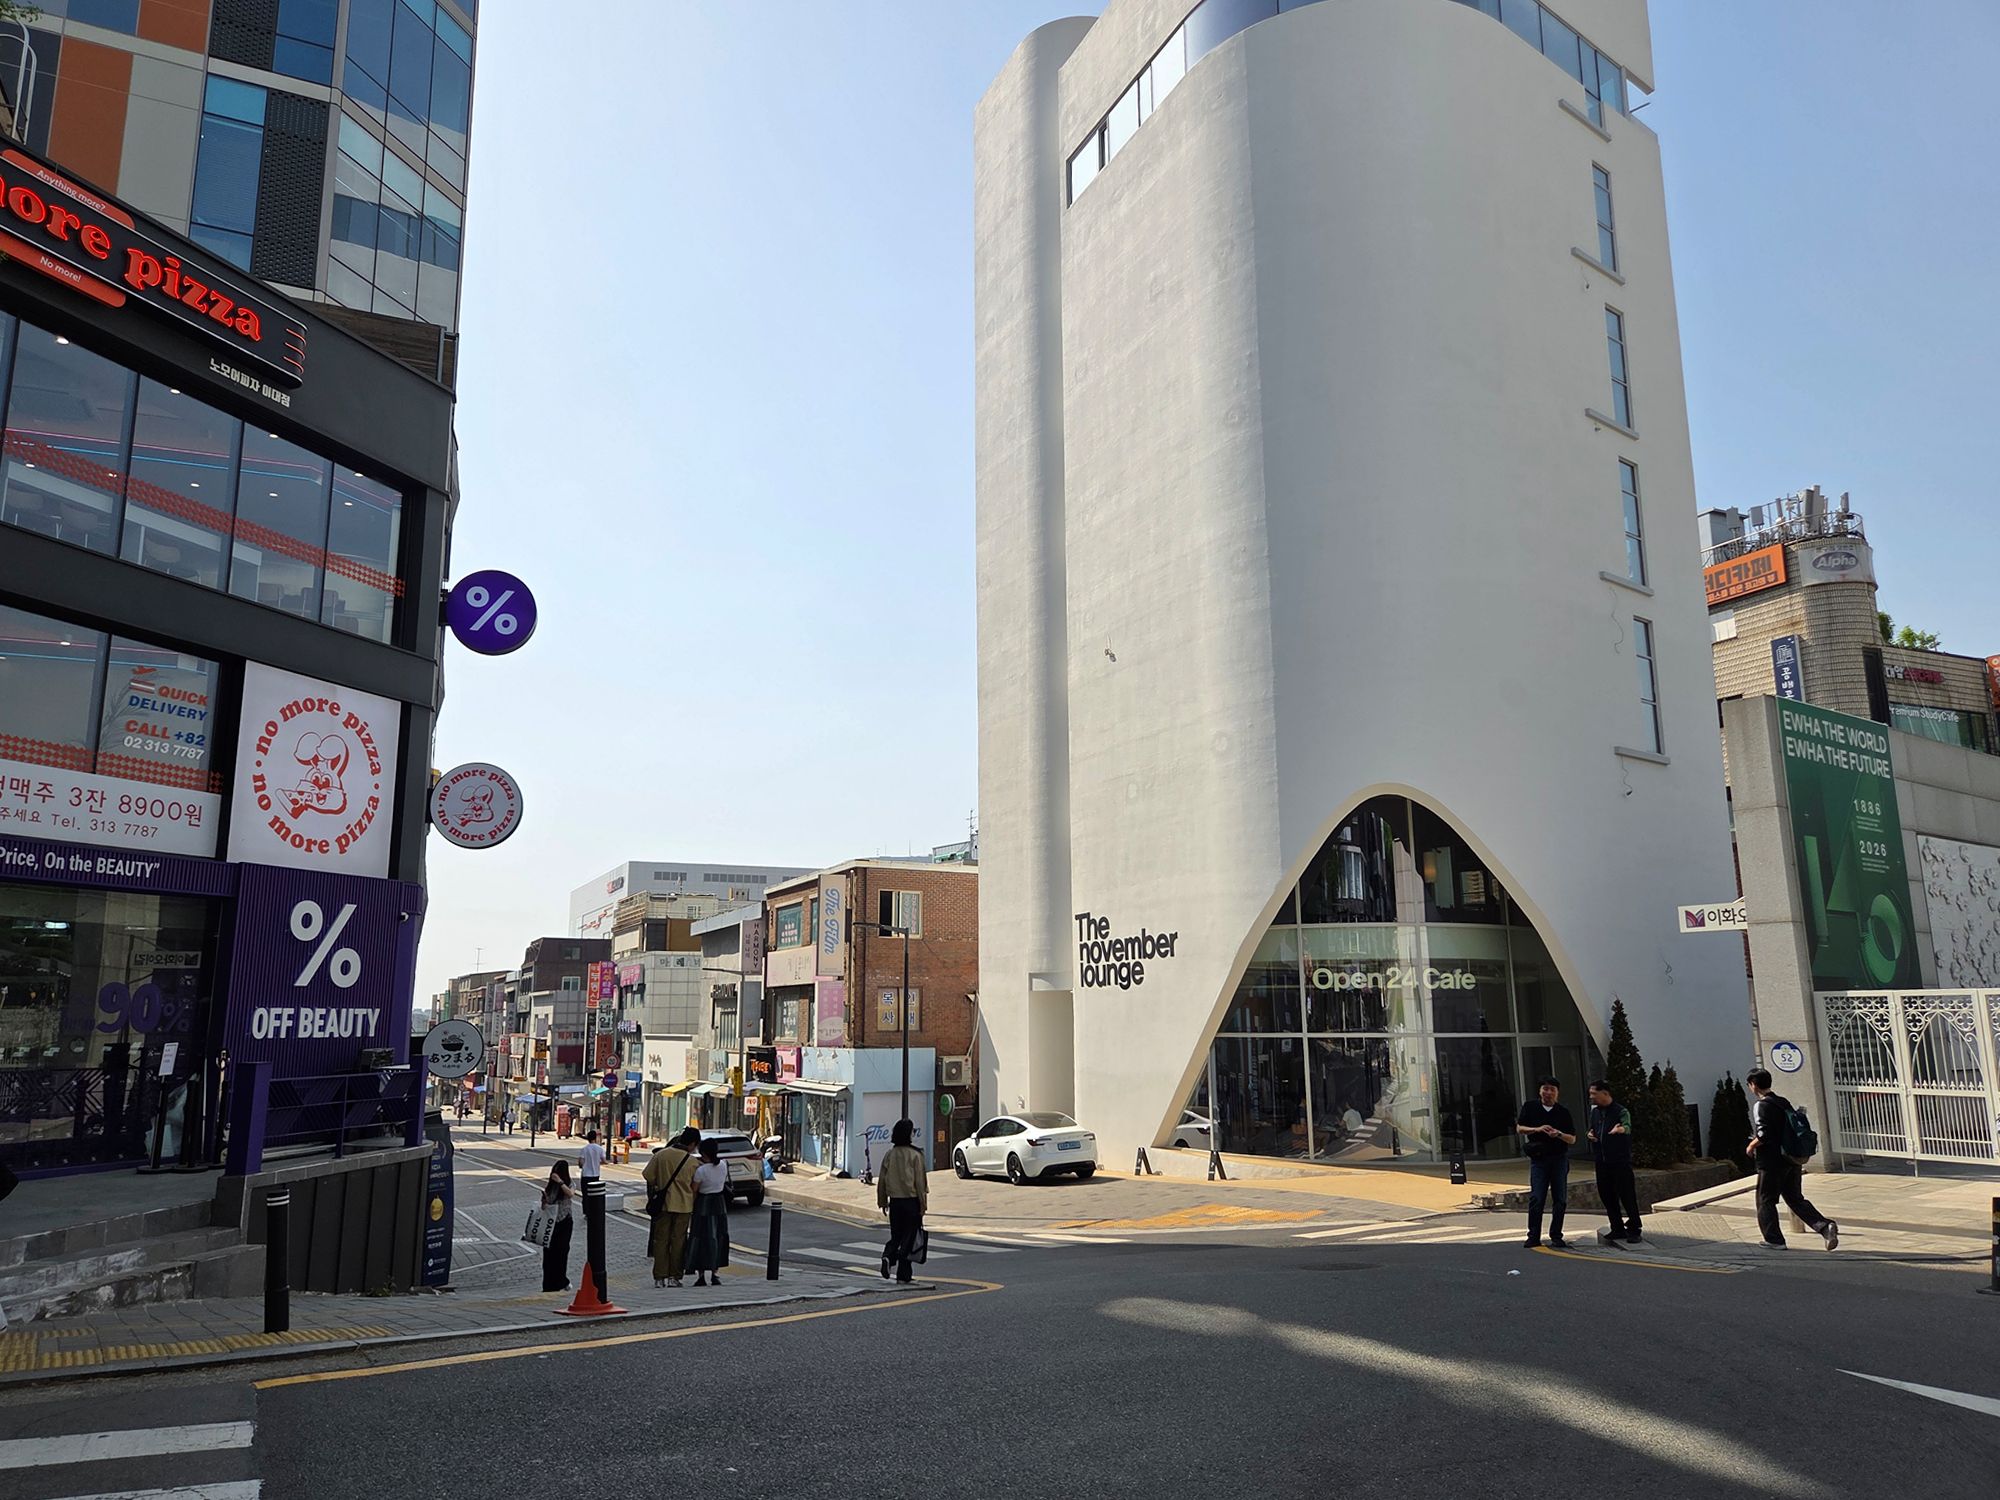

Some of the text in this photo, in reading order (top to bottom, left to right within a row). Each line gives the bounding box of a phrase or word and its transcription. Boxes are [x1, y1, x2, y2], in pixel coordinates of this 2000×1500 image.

[37, 170, 106, 211] Anything more?
[0, 175, 262, 342] ore pizza
[40, 255, 82, 283] No more!
[209, 358, 291, 408] 노모어피자 이대점
[1817, 554, 1856, 568] Alpha
[128, 695, 208, 721] DELIVERY
[158, 685, 209, 706] QUICK
[125, 719, 206, 746] CALL +82
[256, 697, 382, 776] no more pizza
[1782, 710, 1887, 754] EWHA THE WORLD
[123, 736, 205, 760] 02 313 7787
[1786, 736, 1891, 779] EWHA THE FUTURE
[438, 769, 515, 801] no more pizza
[69, 786, 107, 814] 3잔
[118, 794, 202, 828] 8900원
[252, 773, 381, 854] no more pizza
[1853, 799, 1881, 816] 1886
[51, 813, 81, 831] Tel.
[90, 818, 116, 833] 313
[124, 823, 158, 839] 7787
[437, 809, 515, 841] no more pizza
[44, 851, 66, 871] On
[69, 854, 92, 873] the
[1859, 840, 1887, 857] 2026
[824, 888, 842, 915] The
[824, 919, 842, 956] Film
[1075, 912, 1110, 942] The
[1080, 928, 1178, 964] november
[1080, 961, 1144, 990] lounge
[1312, 967, 1476, 992] Open 24 Cafe
[252, 1007, 381, 1039] OFF BEAUTY
[429, 1052, 475, 1064] あつまる
[1781, 1053, 1793, 1062] 52
[866, 1124, 891, 1141] The
[531, 1217, 555, 1248] EOUL TOKYO
